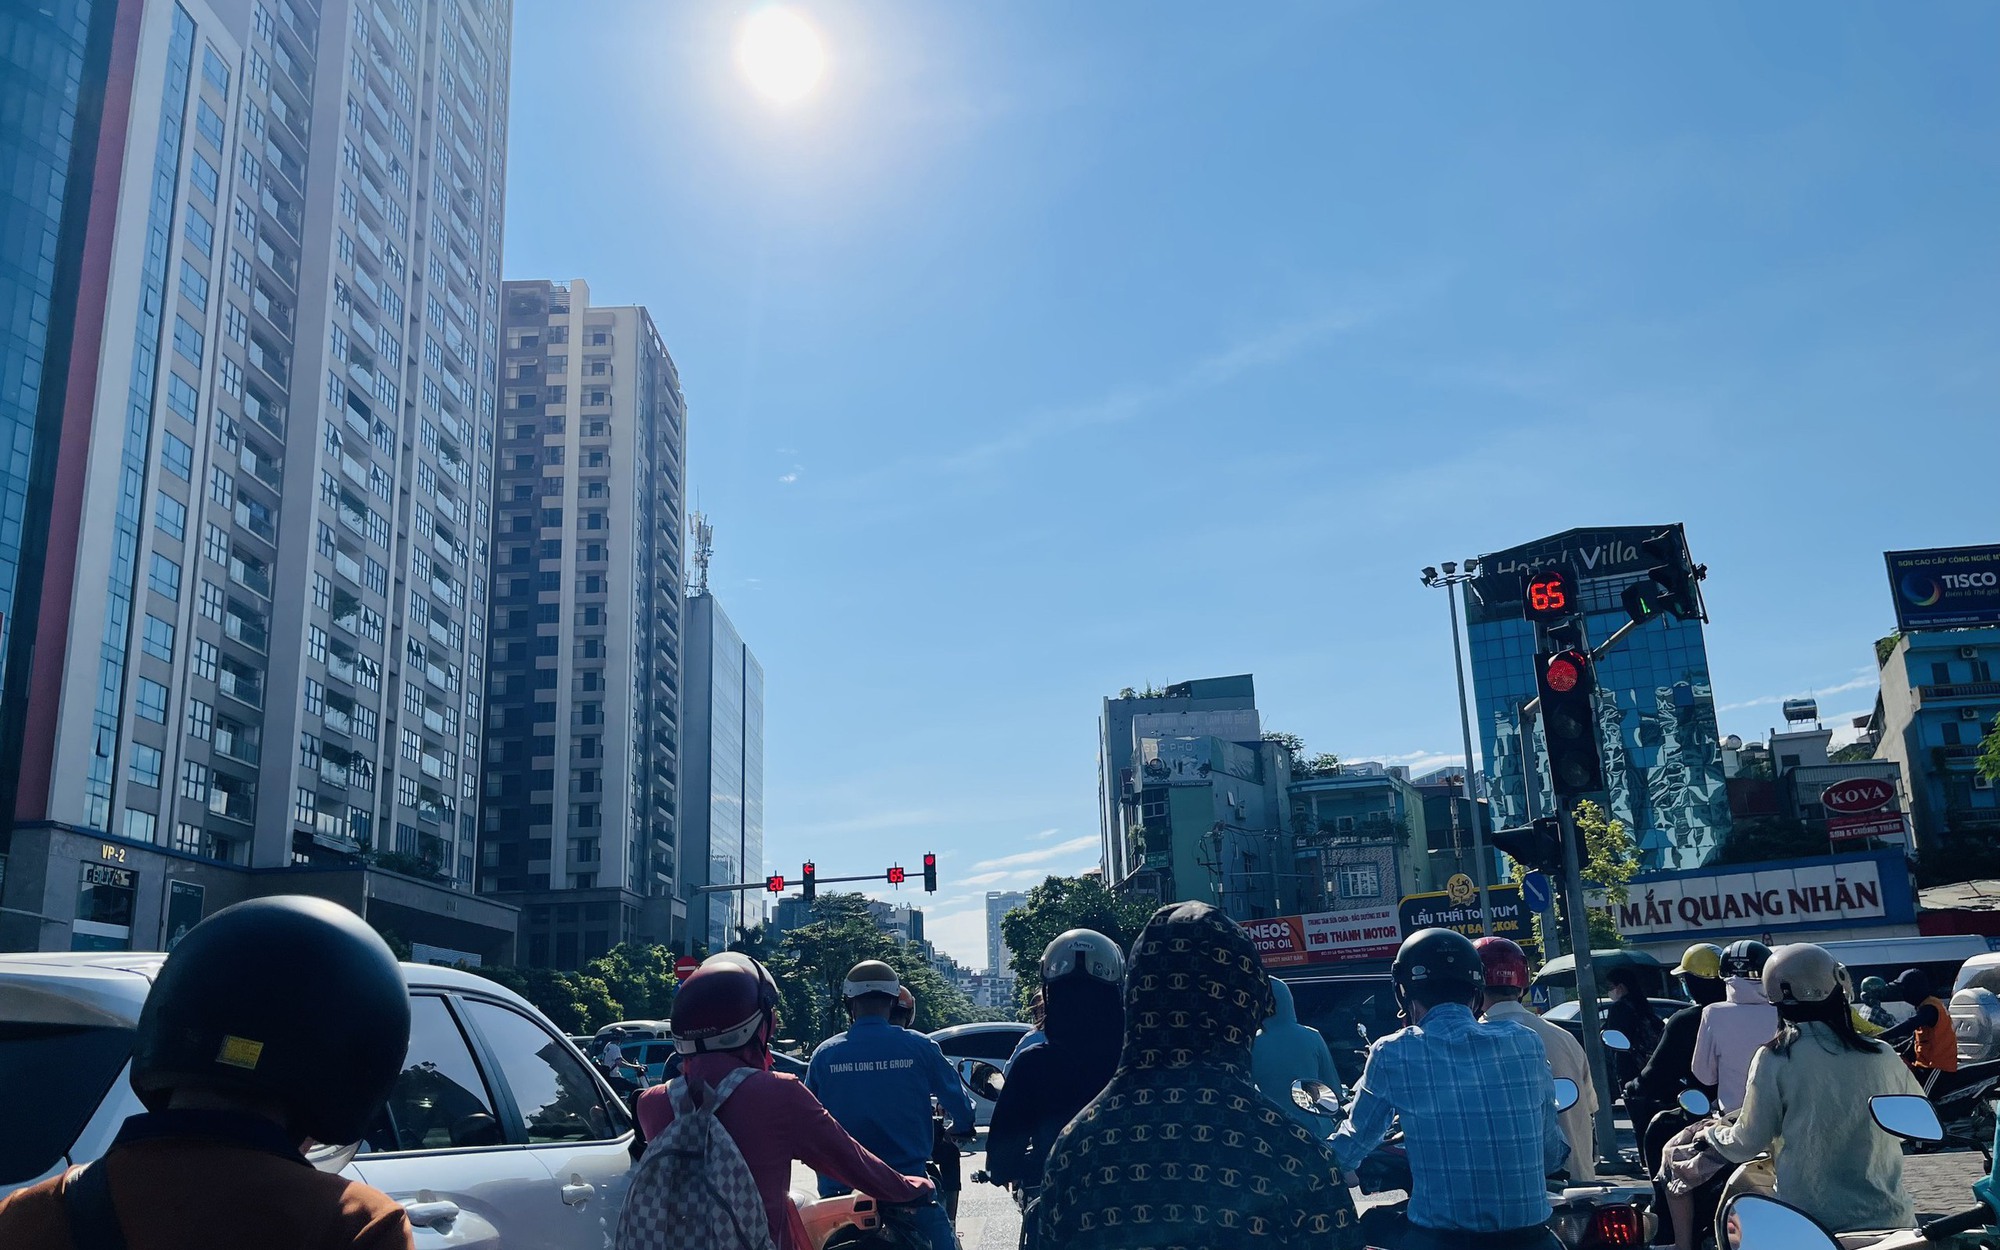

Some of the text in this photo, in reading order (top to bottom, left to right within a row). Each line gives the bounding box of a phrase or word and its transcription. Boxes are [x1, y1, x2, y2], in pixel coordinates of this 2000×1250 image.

[1579, 540, 1639, 570] Villa
[1941, 572, 1997, 589] TISCO
[1530, 580, 1565, 611] 65
[1830, 786, 1886, 805] KOVA
[889, 868, 904, 883] 65
[769, 877, 784, 891] 20
[1619, 888, 1674, 929] MẮT
[1678, 888, 1785, 927] QUANG
[1786, 877, 1880, 916] NHÃN
[1490, 904, 1519, 919] YUM
[1364, 925, 1398, 940] MOTOR
[1468, 920, 1520, 935] BAGKOK
[1254, 938, 1293, 951] TOR OIL
[829, 1058, 914, 1073] THANG LONG TLE GROUP
